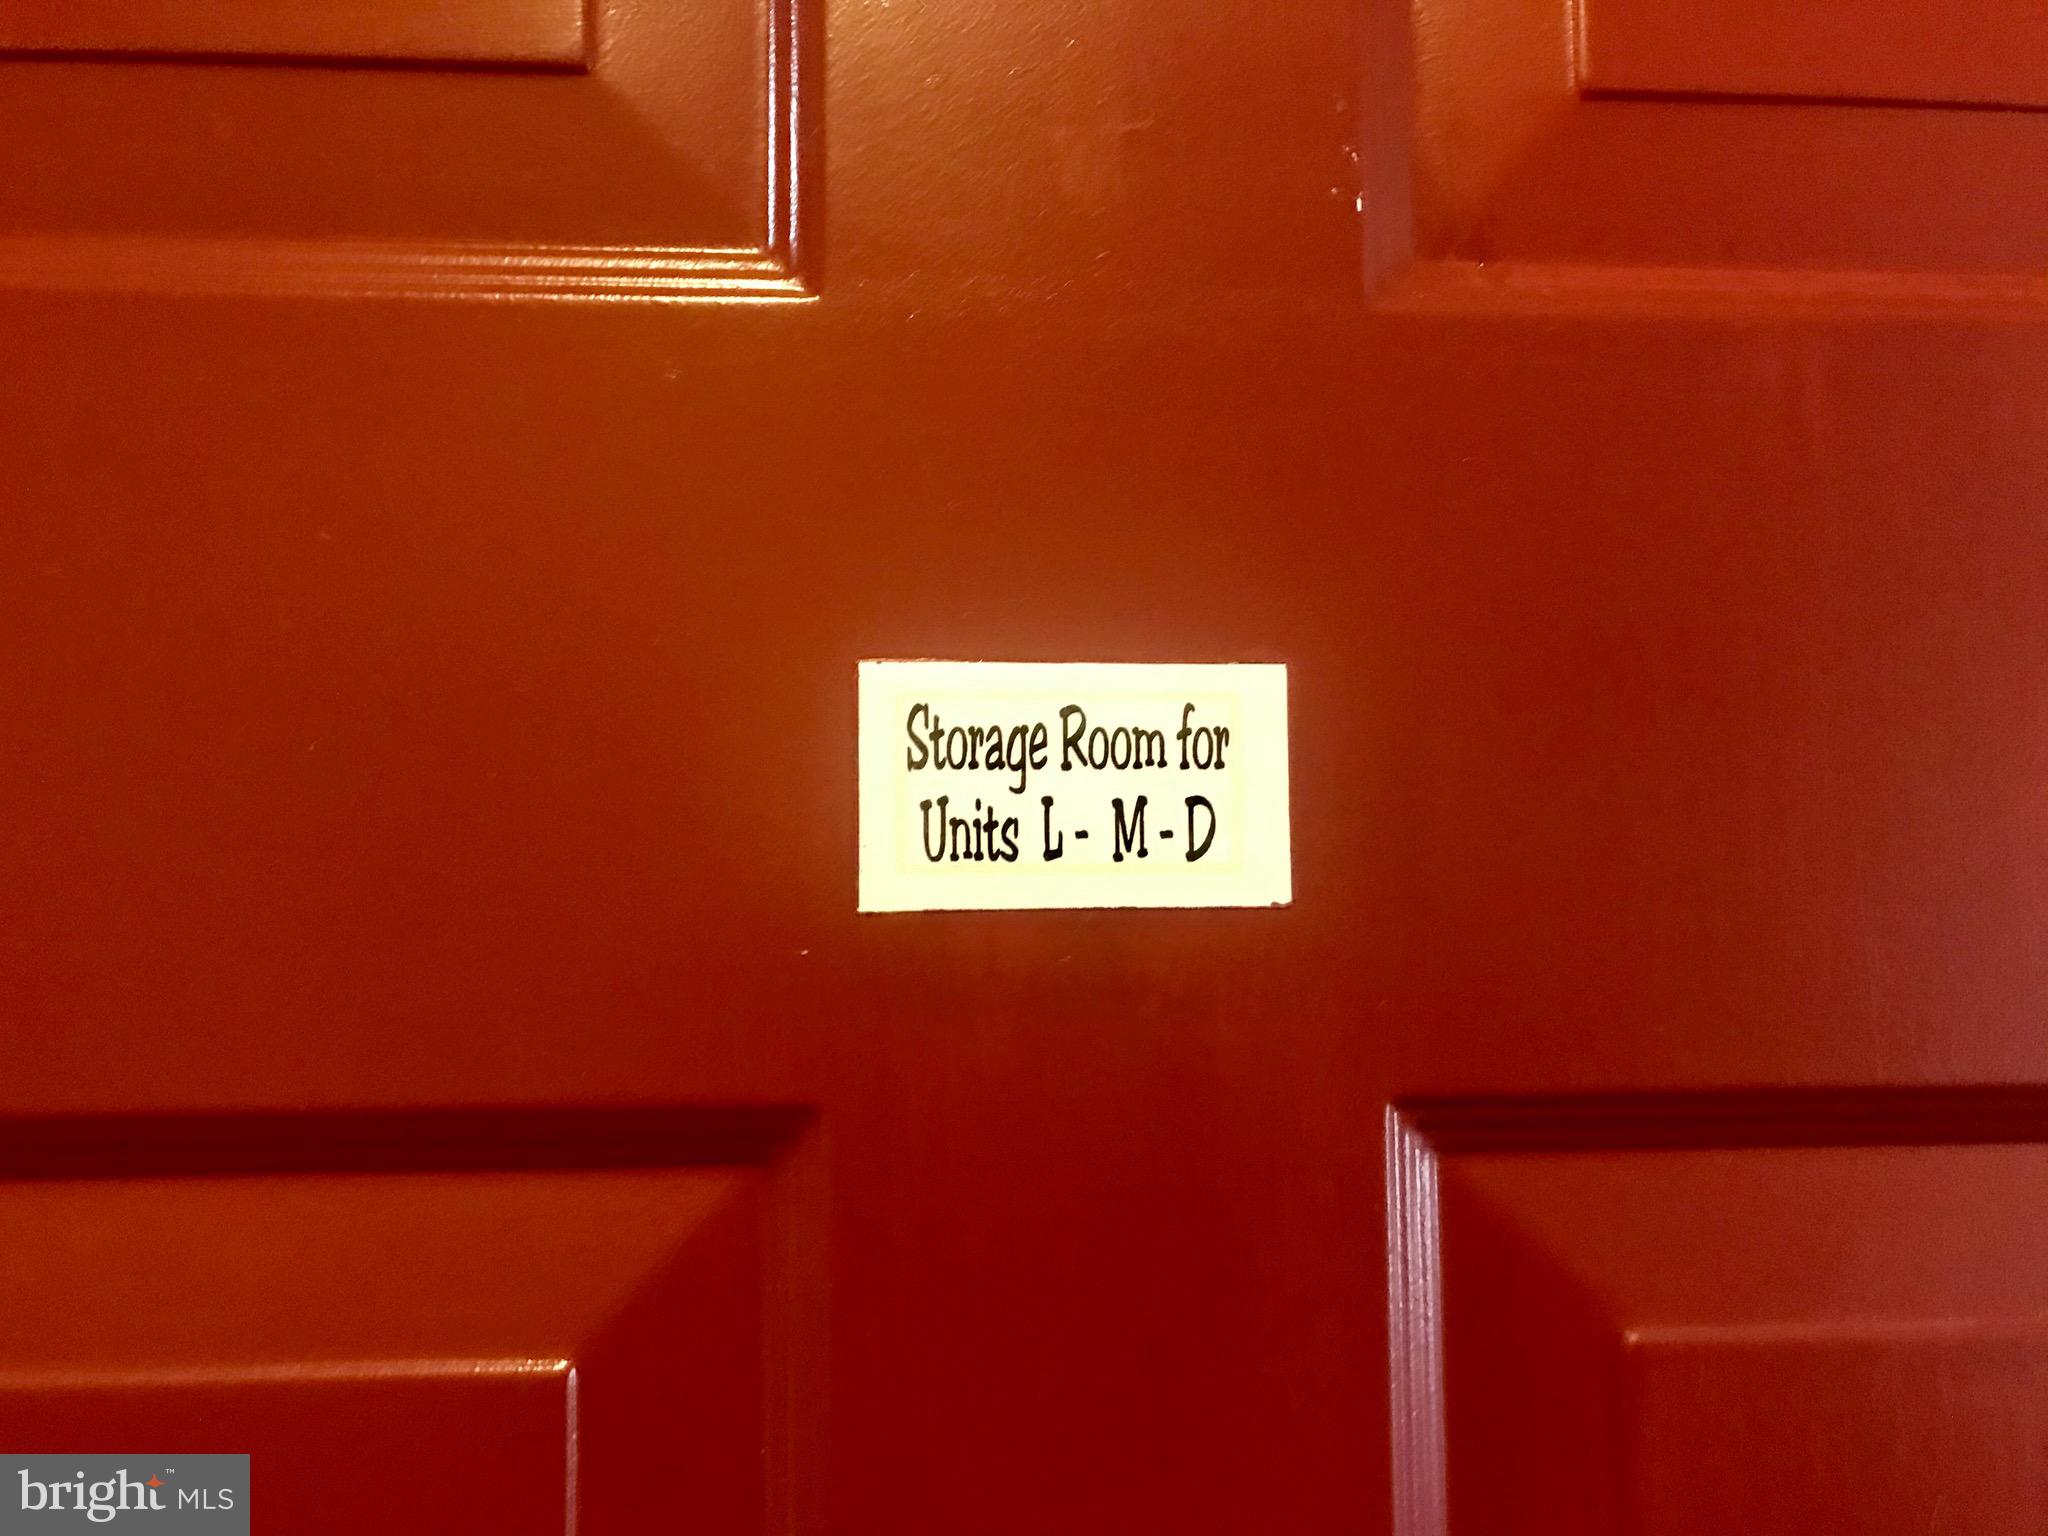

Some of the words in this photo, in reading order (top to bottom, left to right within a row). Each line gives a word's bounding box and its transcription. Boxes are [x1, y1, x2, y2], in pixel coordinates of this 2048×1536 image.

[906, 703, 1048, 795] Storage
[1059, 704, 1168, 772] Room
[1176, 702, 1230, 771] for
[919, 795, 1019, 863] Units
